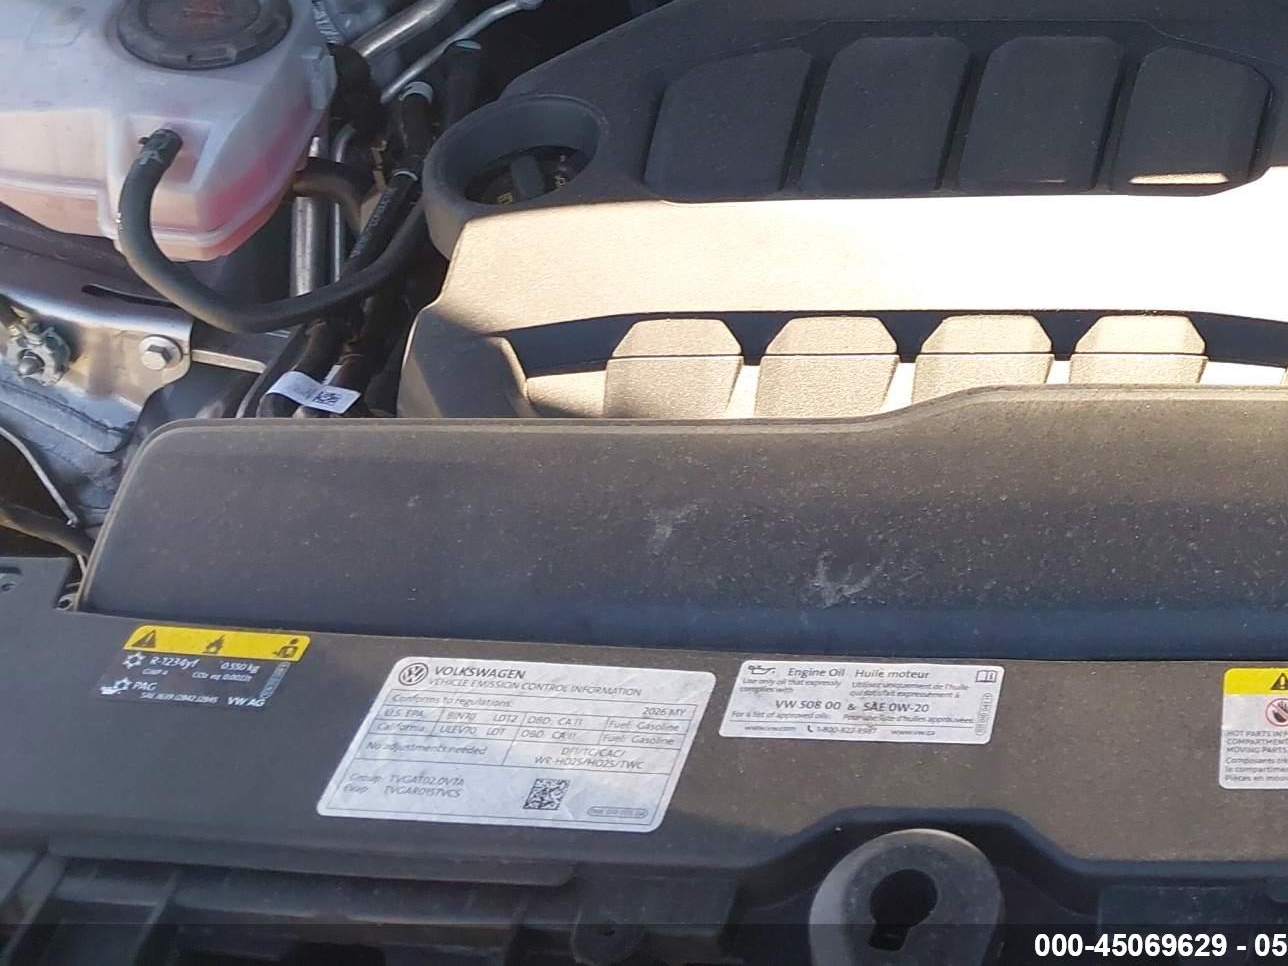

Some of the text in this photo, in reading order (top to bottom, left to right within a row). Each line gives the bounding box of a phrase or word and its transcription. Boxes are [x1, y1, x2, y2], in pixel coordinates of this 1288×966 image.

[434, 666, 526, 679] VOLKSWAGEN
[788, 667, 846, 678] Engine Oil
[855, 669, 930, 679] Huile moteur
[132, 681, 157, 691] PAG
[428, 677, 642, 697] VEHICLE EMISSION CONTROL INFORMATION
[227, 696, 249, 706] VW
[246, 698, 265, 707] AG
[392, 694, 440, 704] Conforms
[775, 699, 797, 709] VW
[799, 700, 822, 709] 508
[825, 701, 842, 710] 00
[863, 701, 930, 713] SAE 0W-20
[637, 721, 679, 732] Gasoline
[632, 735, 674, 745] Gasoline
[366, 741, 488, 755] No adjustments needed
